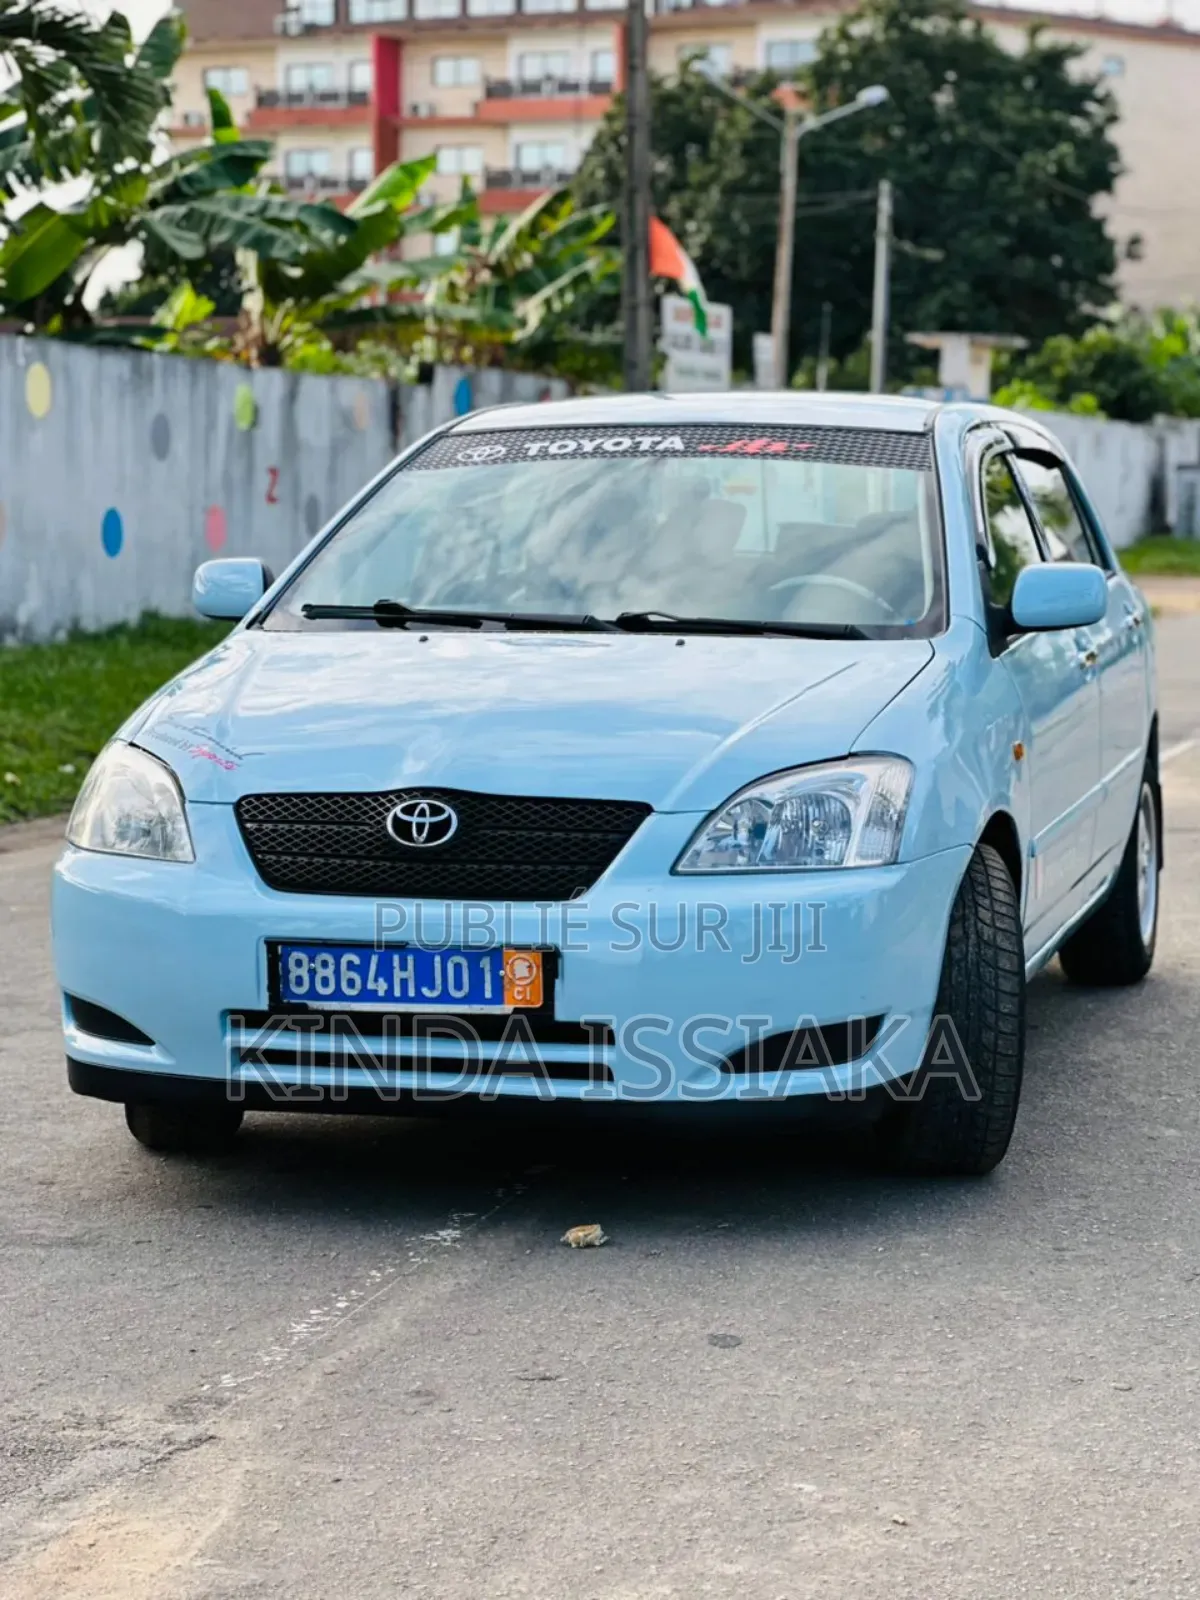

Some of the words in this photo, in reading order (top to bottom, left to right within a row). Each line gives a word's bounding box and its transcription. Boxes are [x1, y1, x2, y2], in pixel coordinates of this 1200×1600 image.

[524, 435, 685, 456] TOYOTA
[287, 951, 494, 1000] 8864HJ01
[513, 987, 531, 1001] CI
